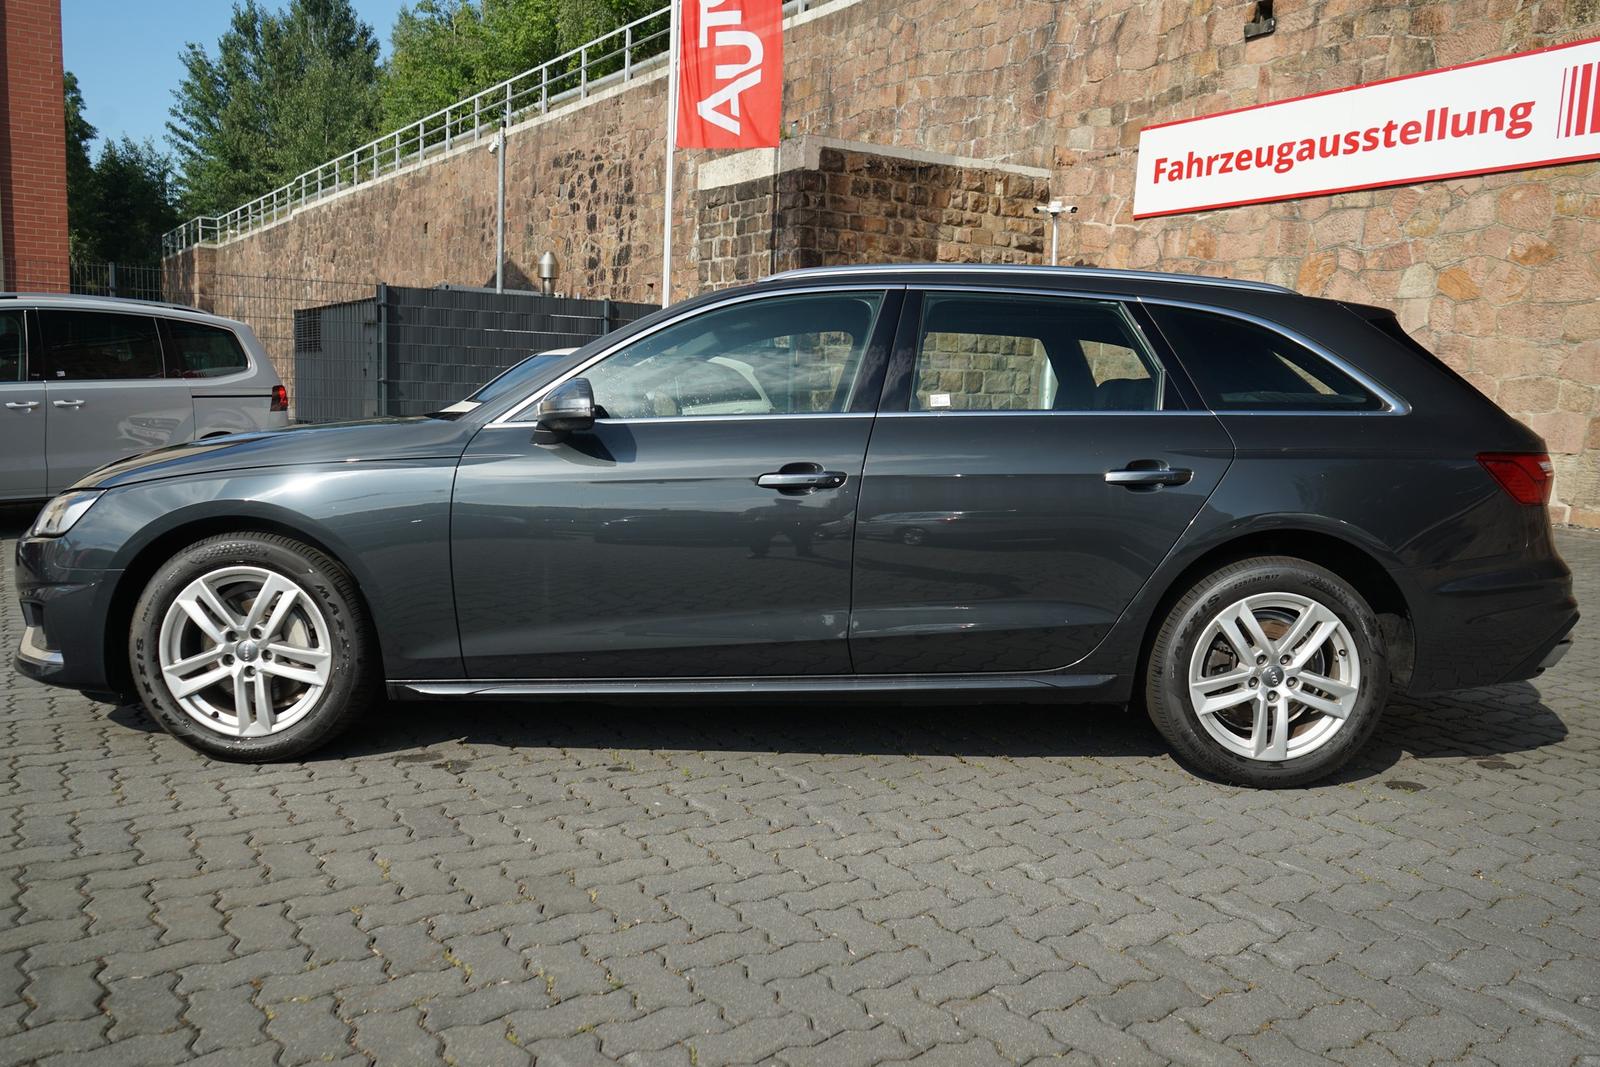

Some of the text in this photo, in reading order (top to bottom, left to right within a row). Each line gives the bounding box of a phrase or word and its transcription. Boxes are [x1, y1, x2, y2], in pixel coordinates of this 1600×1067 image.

[696, 0, 764, 136] AUT
[1153, 101, 1536, 184] Fahrzeugausstellung
[1169, 593, 1220, 679] AXXIS
[136, 637, 177, 726] MAXXIS
